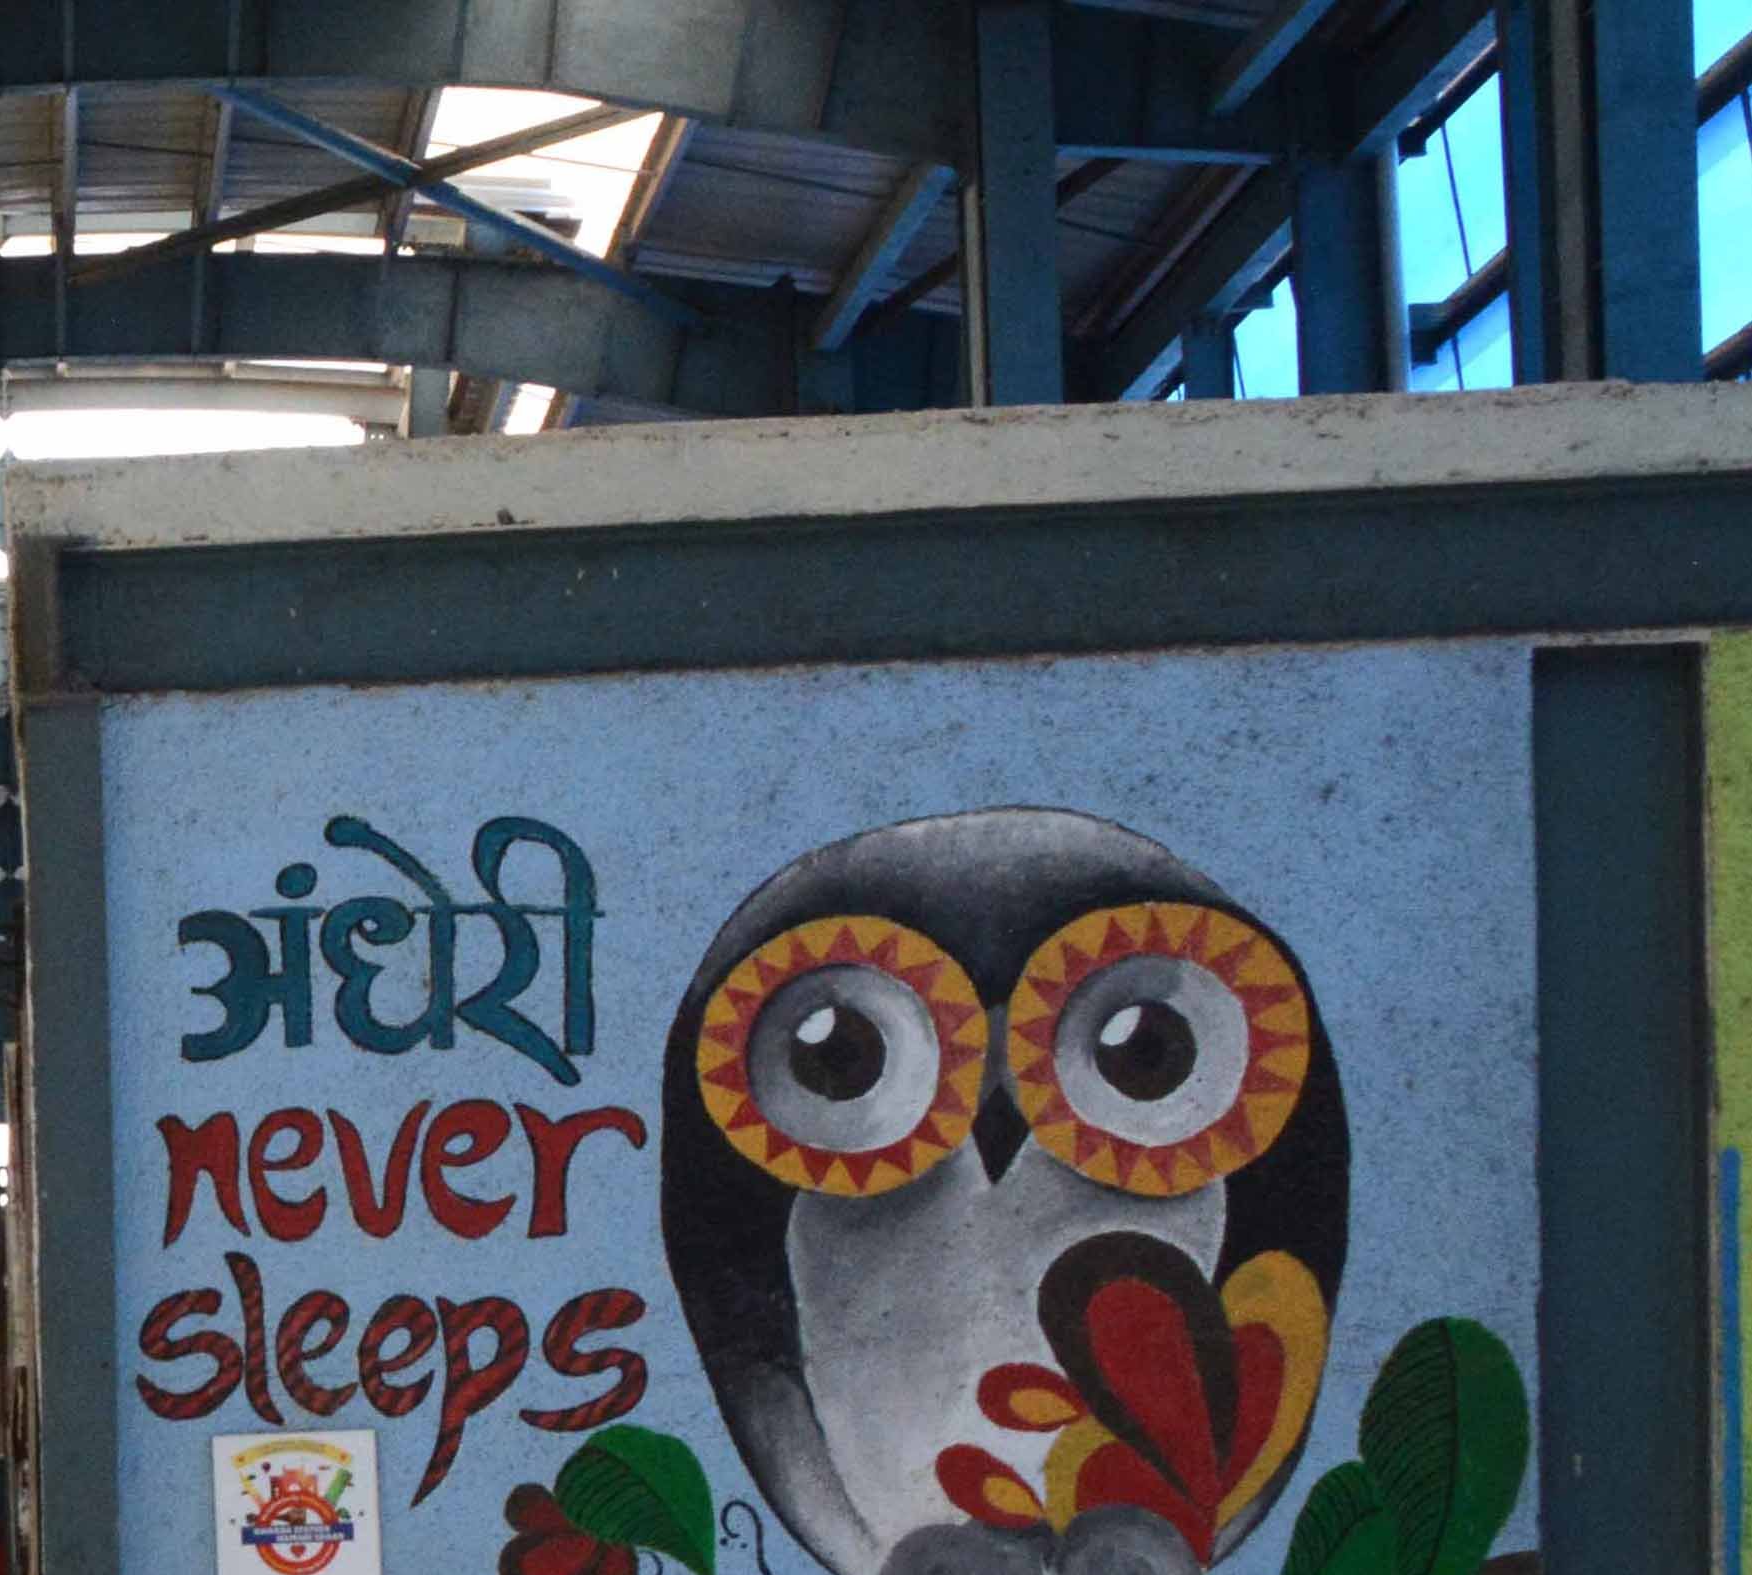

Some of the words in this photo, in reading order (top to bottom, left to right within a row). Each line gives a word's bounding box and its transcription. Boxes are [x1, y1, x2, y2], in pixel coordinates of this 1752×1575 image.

[177, 815, 606, 1087] अंधेरी
[156, 1097, 647, 1249] never
[135, 1250, 649, 1510] sleeps
